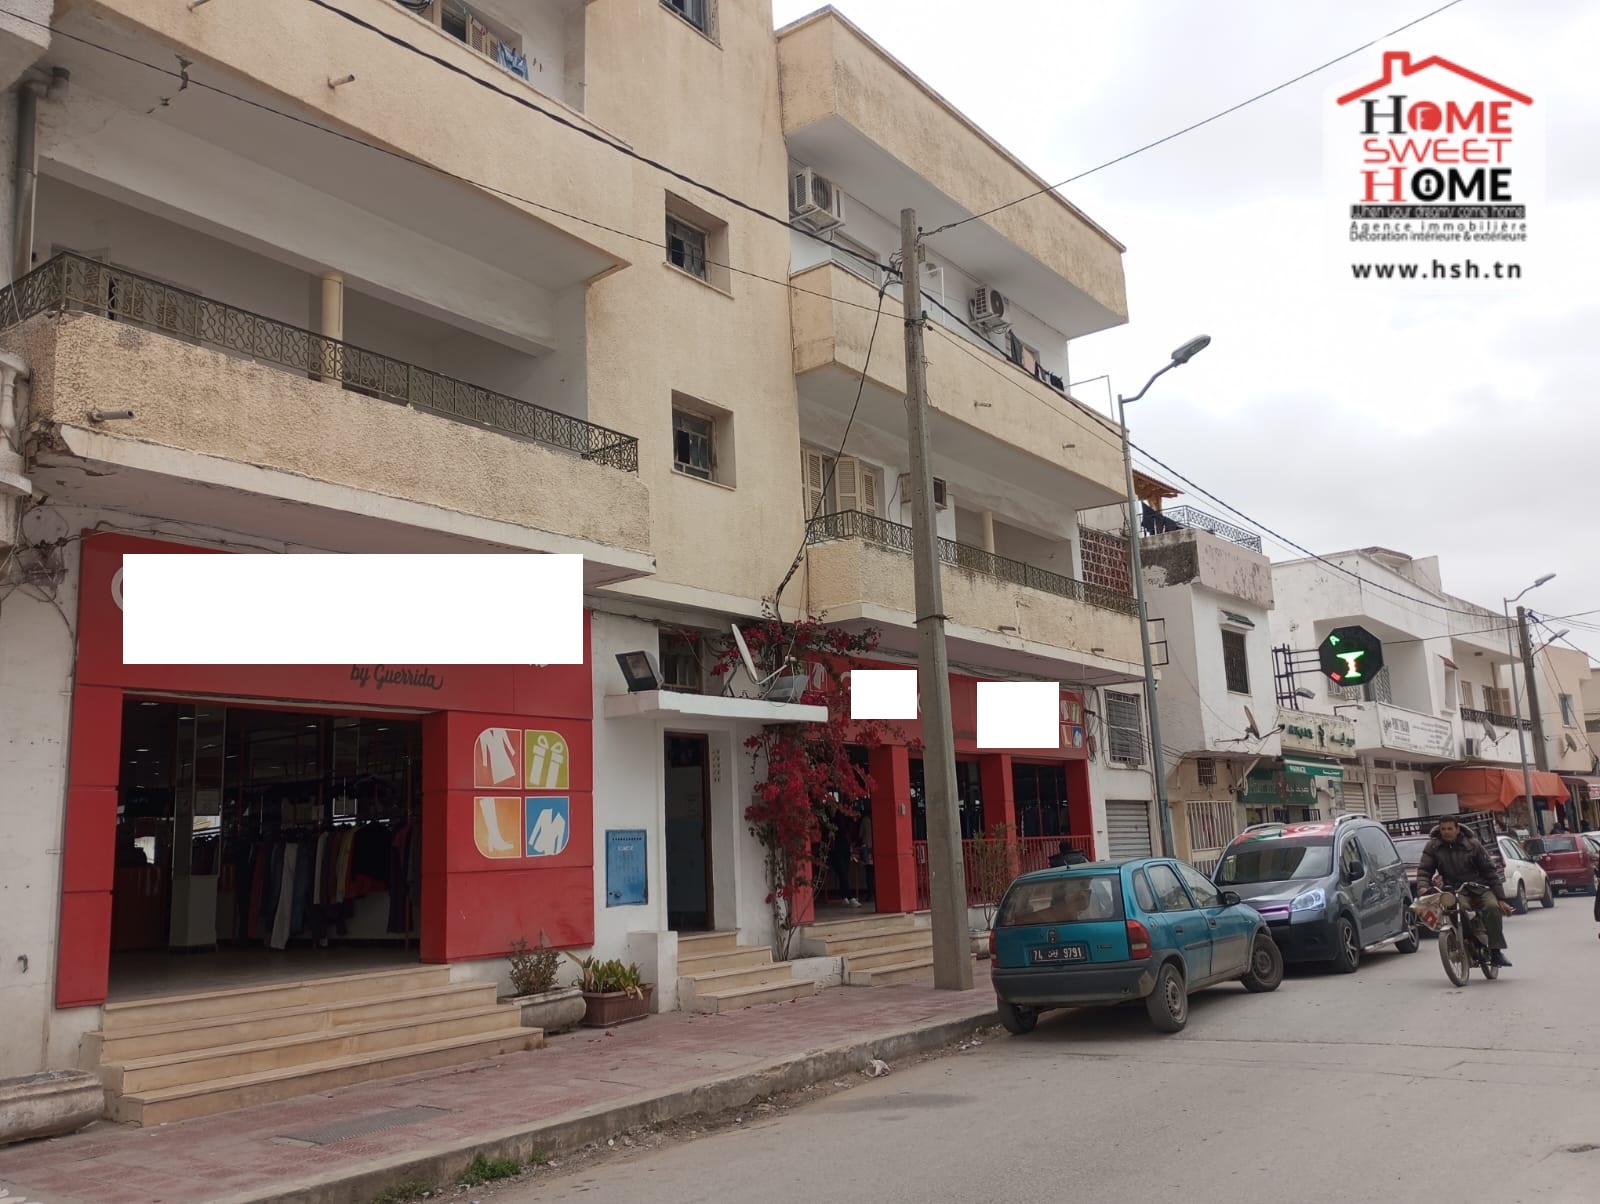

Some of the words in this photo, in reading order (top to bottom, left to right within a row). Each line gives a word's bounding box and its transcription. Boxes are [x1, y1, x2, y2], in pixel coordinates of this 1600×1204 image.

[351, 664, 370, 687] by
[374, 664, 444, 690] Guerrida
[1063, 947, 1082, 958] 9791
